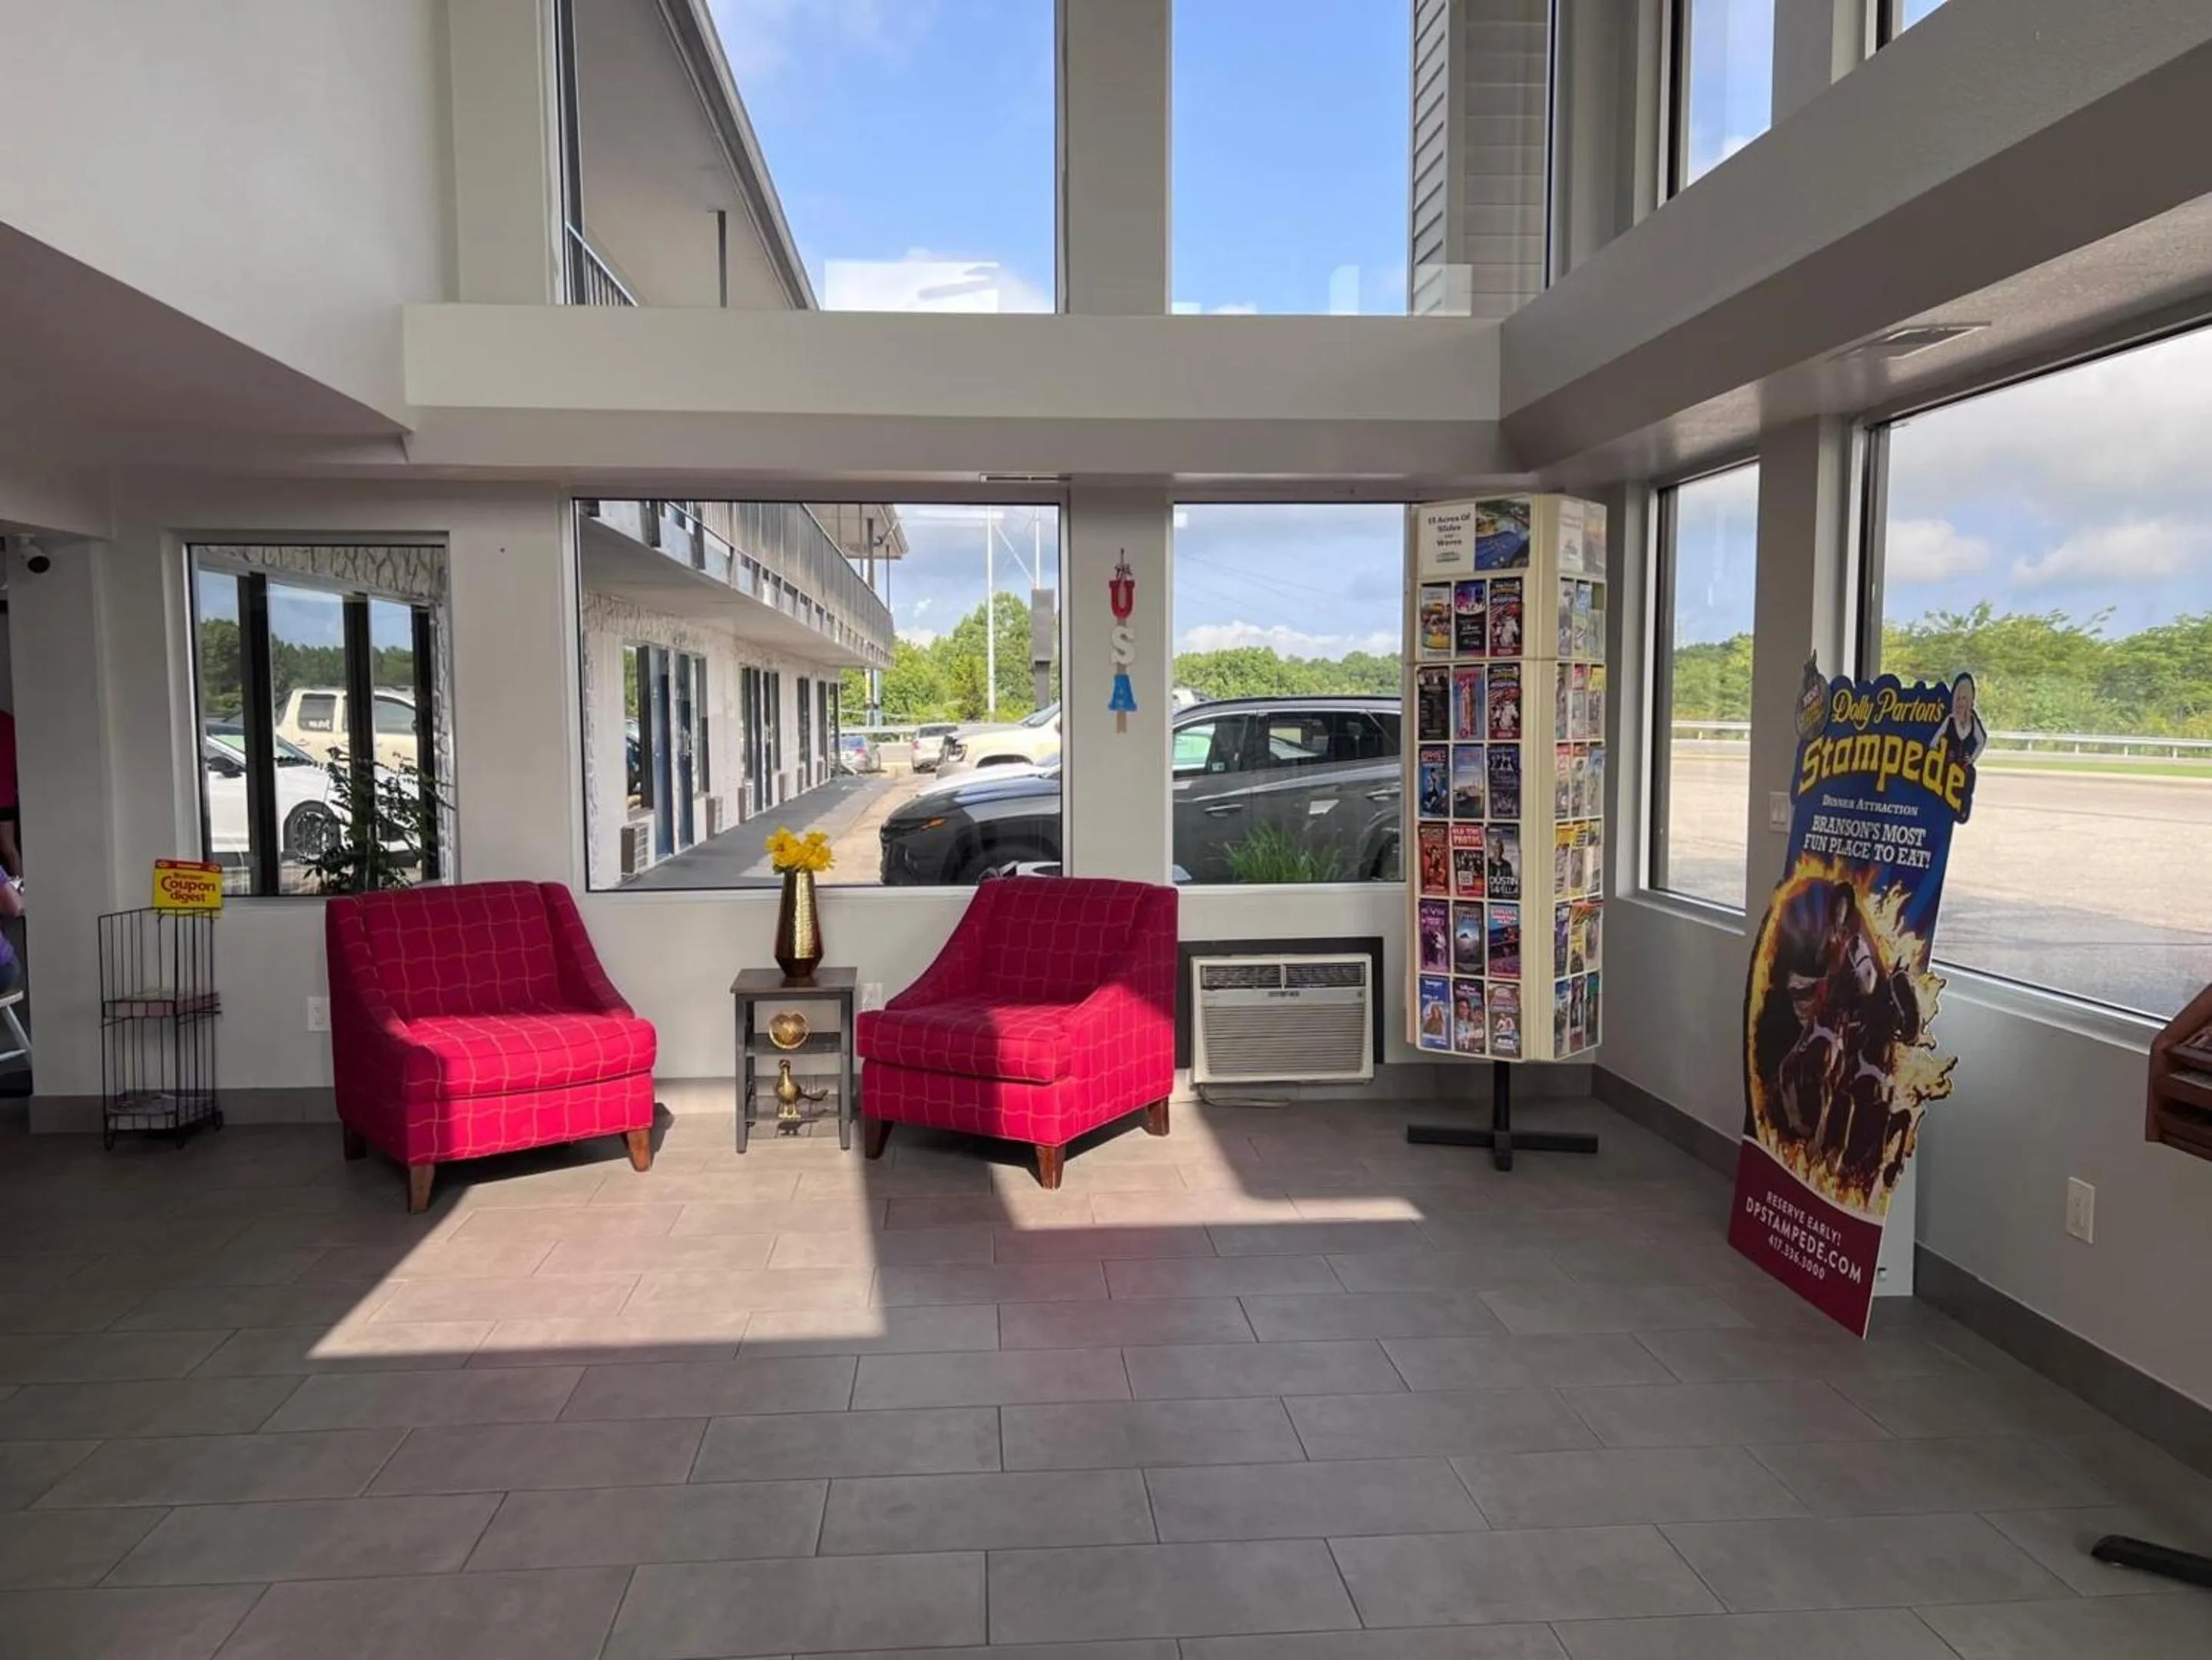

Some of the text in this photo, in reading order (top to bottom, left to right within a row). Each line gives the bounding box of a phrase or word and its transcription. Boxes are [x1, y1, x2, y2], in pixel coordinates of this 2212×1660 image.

[1437, 524, 1461, 533] Slides
[1109, 579, 1137, 711] USA
[1832, 688, 1874, 731] Dolly
[1873, 688, 1945, 724] Parton's
[1798, 733, 1967, 811] Stampede
[1856, 798, 1919, 817] ATTRACTION
[1812, 815, 1927, 847] BRANSON'S MOST
[1804, 833, 1932, 869] FUN PLACE TO EAT!
[160, 874, 217, 893] Coupon
[170, 890, 206, 904] digest
[1767, 1191, 1842, 1246] RESERVE EARLY!
[1746, 1195, 1862, 1284] DPSTAMPEDE.COM
